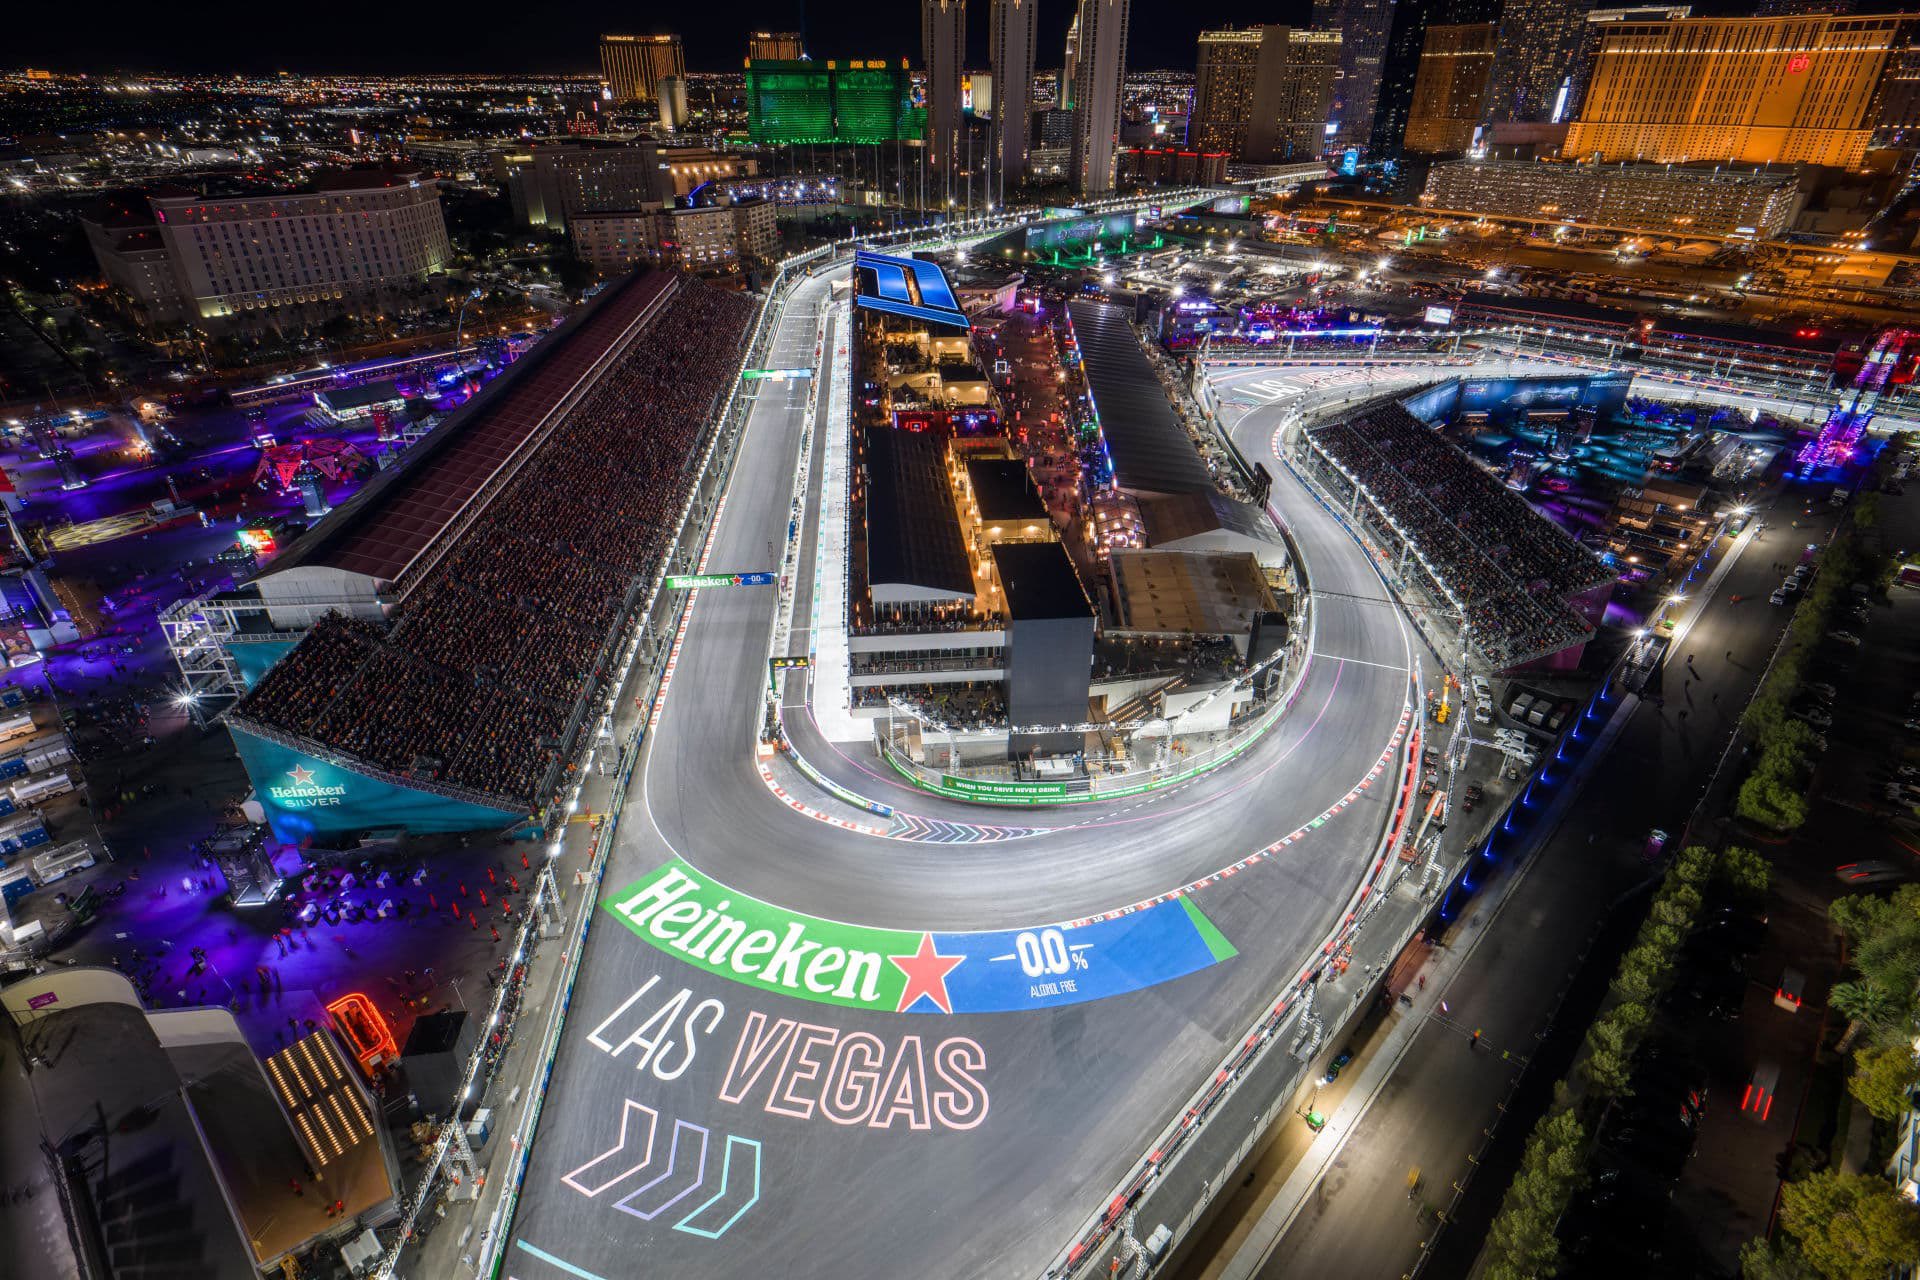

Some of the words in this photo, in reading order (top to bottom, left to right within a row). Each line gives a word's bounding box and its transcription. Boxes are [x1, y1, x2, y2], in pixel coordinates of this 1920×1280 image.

[673, 577, 730, 588] Heineken
[270, 786, 346, 798] Heineken
[956, 782, 976, 790] WHEN
[284, 797, 341, 807] SILVER
[615, 867, 883, 1001] Heineken
[1030, 982, 1061, 998] ALCOHOL
[1060, 980, 1078, 993] FREE
[586, 975, 725, 1081] LAS
[718, 1010, 989, 1130] VEGAS
